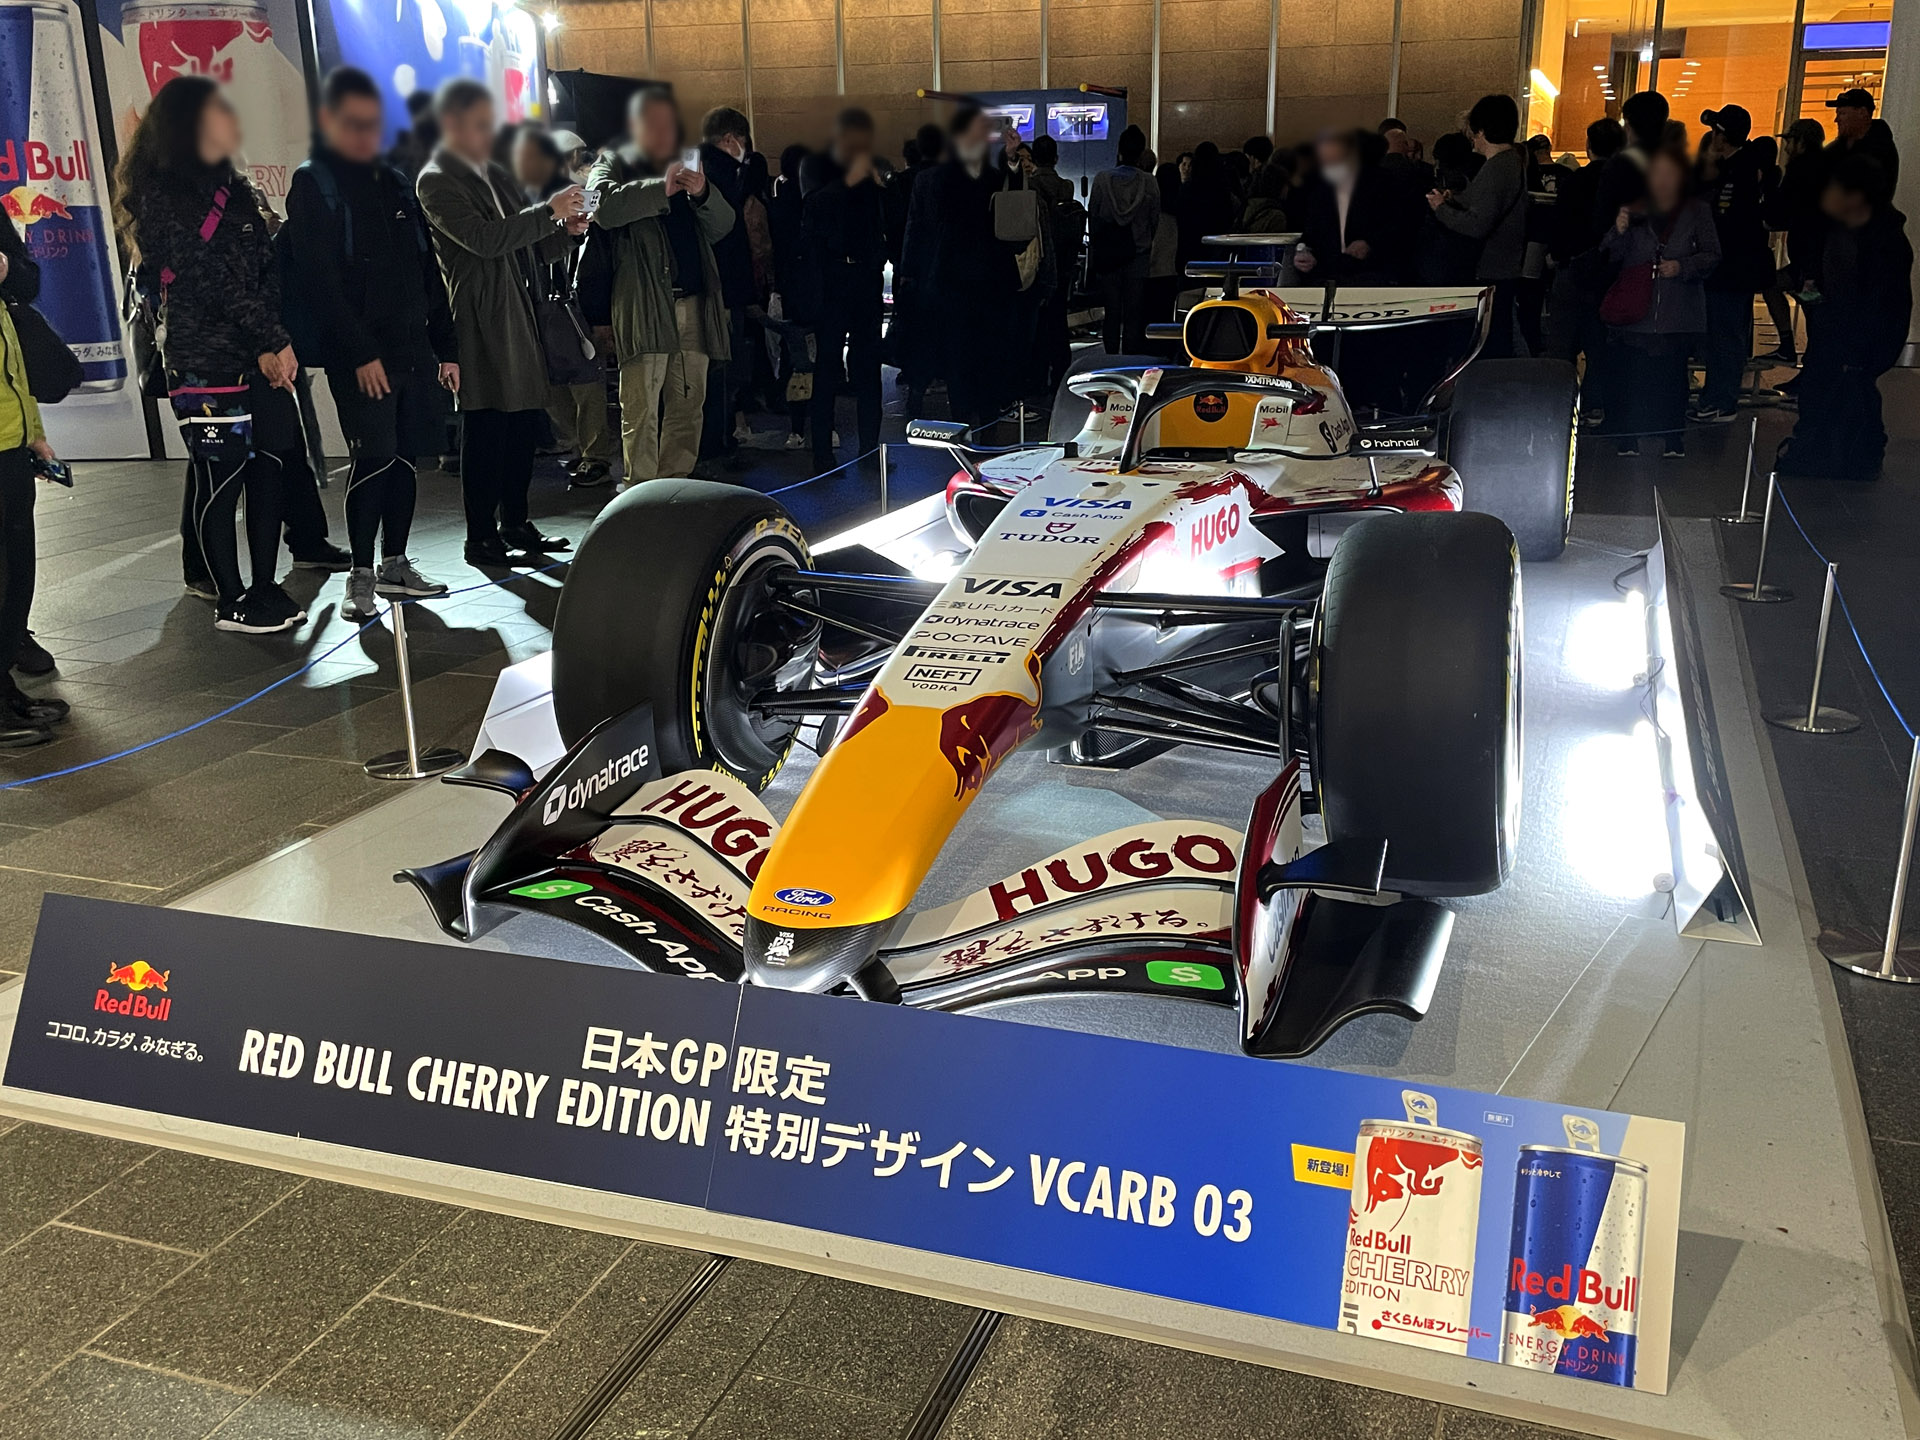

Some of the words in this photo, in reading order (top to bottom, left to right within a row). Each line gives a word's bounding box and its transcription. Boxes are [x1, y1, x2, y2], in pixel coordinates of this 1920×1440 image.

[24, 139, 91, 182] Bull
[1259, 405, 1289, 414] Mobil
[919, 428, 953, 441] hahnair
[1374, 438, 1420, 448] hahnair
[1042, 496, 1133, 510] VISA
[1051, 511, 1089, 519] Cash
[1091, 512, 1124, 521] App
[1000, 531, 1101, 545] TUDOR
[1190, 503, 1240, 561] HUGO
[962, 576, 1064, 600] VISA
[933, 600, 1055, 615] 三菱UFJカード
[943, 614, 1041, 631] dynatrace
[931, 631, 1031, 648] OCTAVE
[902, 645, 1012, 665] PIRELLI
[913, 667, 972, 682] NEFT
[911, 682, 959, 693] VODKA
[567, 743, 650, 810] dynatrace
[987, 833, 1238, 922] HUGO
[784, 888, 824, 905] Ford
[574, 895, 658, 935] Cash
[762, 905, 832, 920] RACING
[1033, 966, 1127, 981] App
[94, 988, 133, 1017] Red
[134, 994, 171, 1022] Bull
[45, 1021, 204, 1063] ココロ、カラダ、みなぎる。
[238, 1028, 304, 1080] RED
[313, 1040, 393, 1096] BULL
[406, 1055, 549, 1120] CHERRY
[556, 1078, 711, 1147] EDITION
[725, 1104, 1016, 1194] 特別デザイン
[1029, 1153, 1178, 1228] VCARB
[1192, 1183, 1255, 1243] 03
[1350, 1227, 1373, 1249] Red
[1374, 1231, 1412, 1255] Bull
[1347, 1249, 1470, 1297] CHERRY
[1344, 1279, 1401, 1303] EDITION
[1511, 1257, 1572, 1301] Red
[1577, 1268, 1637, 1313] Bull
[1381, 1309, 1492, 1339] さくらんぼフレーバー
[1508, 1332, 1571, 1356] ENERGY
[1529, 1352, 1599, 1374] エナジードリンク
